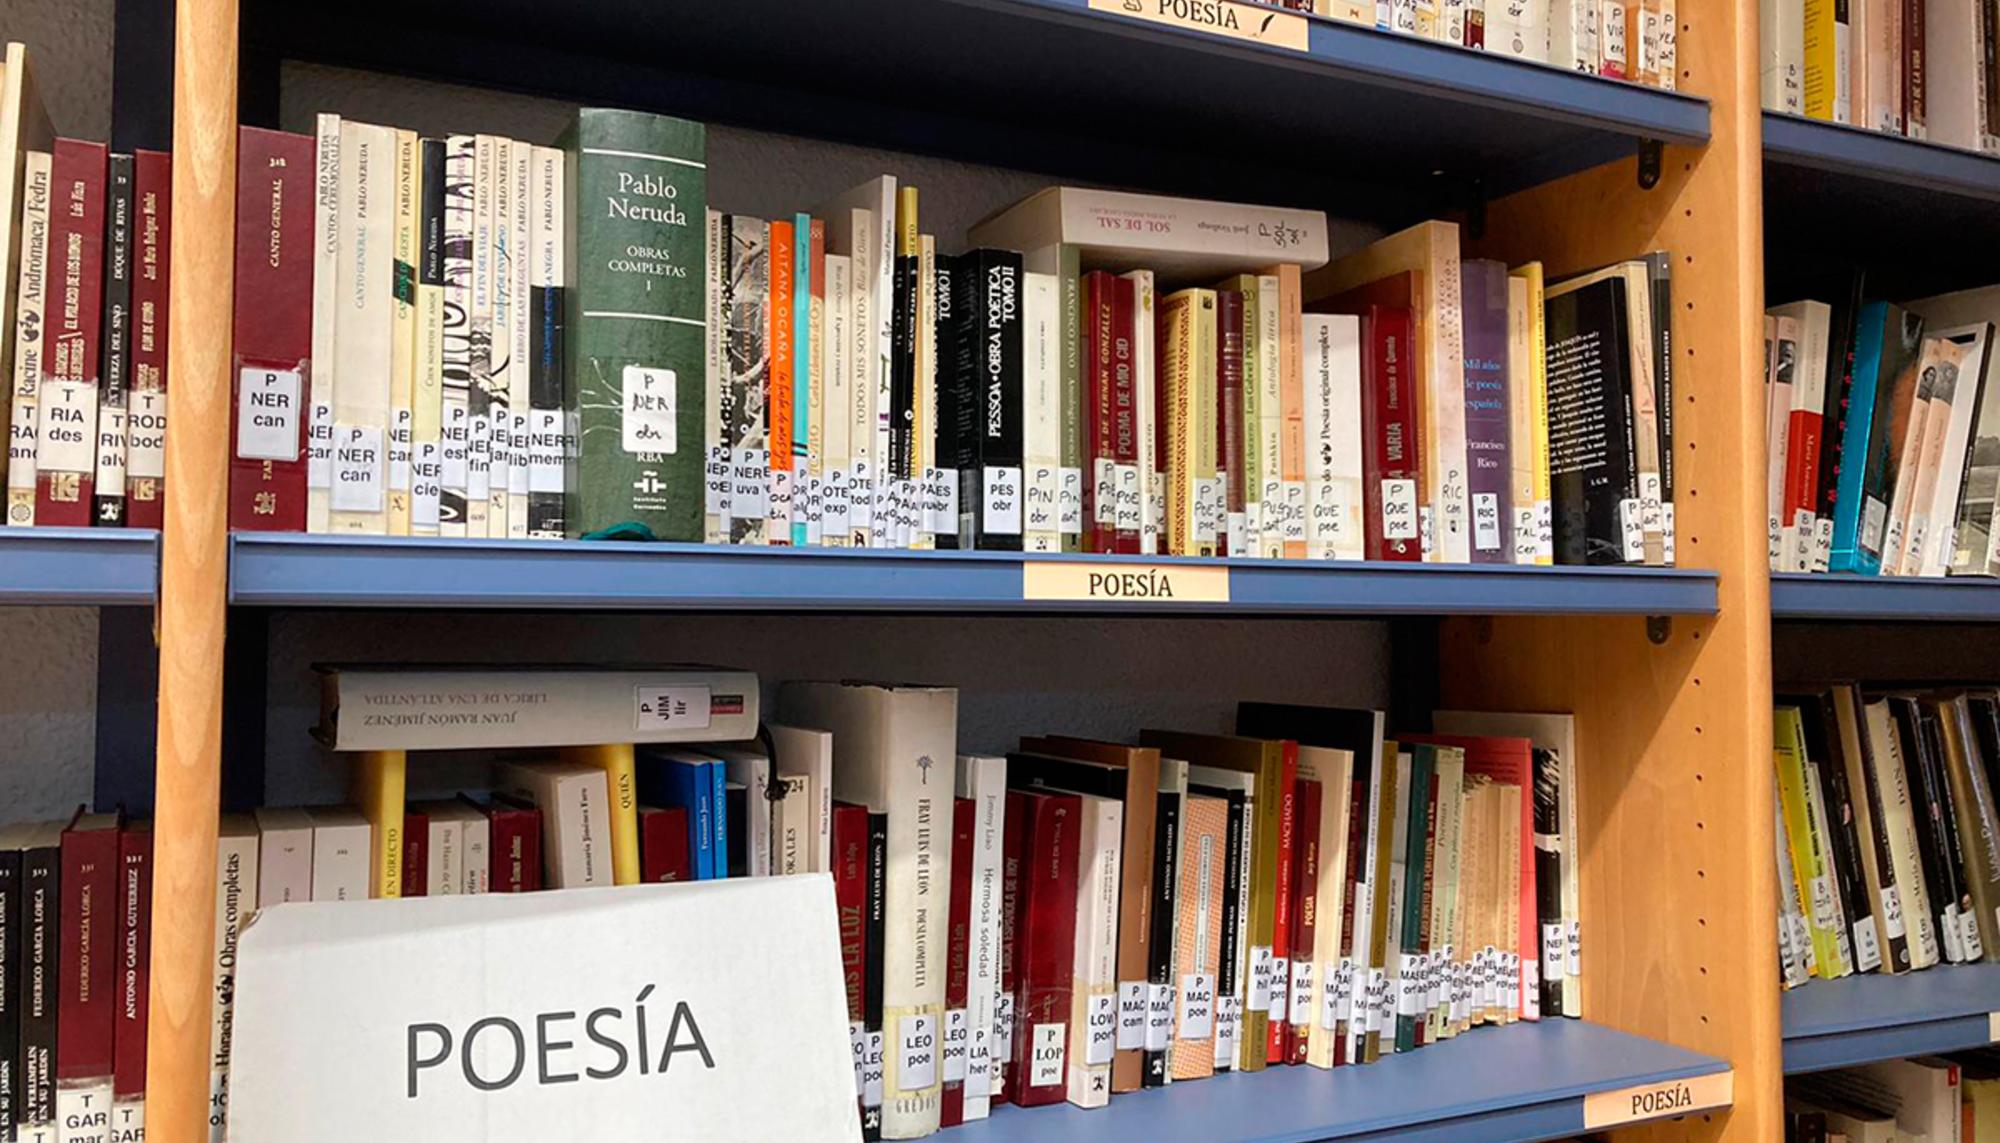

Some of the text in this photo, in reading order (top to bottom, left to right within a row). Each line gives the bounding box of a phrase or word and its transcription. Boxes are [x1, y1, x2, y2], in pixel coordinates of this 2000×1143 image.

[1159, 0, 1239, 30] POESÍA
[480, 142, 489, 218] PABLO NERUDA
[617, 172, 677, 199] Pablo
[518, 159, 528, 233] PABLO NERUDA
[545, 159, 555, 232] PABLO NERUDA
[607, 197, 687, 226] Neruda
[270, 179, 283, 267] CANTO GENERAL
[1096, 217, 1171, 233] SOL DE SAL
[115, 229, 124, 242] DE
[627, 246, 669, 261] OBRAS
[608, 260, 686, 279] COMPLETAS
[778, 242, 789, 302] AITANA
[18, 171, 48, 398] Racine Andrómaca/Fedra
[938, 276, 951, 322] TOMO
[1002, 276, 1015, 323] TOMO
[777, 306, 791, 363] OCAÑA
[1244, 310, 1254, 359] PORTILLO
[988, 265, 1002, 438] PESSOA OBRA POETICA
[855, 295, 866, 426] TODOS MIS SONETOS
[1101, 302, 1111, 435] DE FERNAN GONZALEZ
[265, 374, 277, 386] P
[1320, 325, 1331, 439] Poesía original completa
[62, 389, 75, 402] T
[143, 396, 155, 409] T
[251, 394, 290, 408] NER
[1115, 338, 1131, 455] POEMA DE MIO CID
[23, 406, 34, 420] T
[51, 408, 84, 424] RIA
[316, 405, 328, 419] P
[399, 411, 410, 425] P
[453, 409, 465, 423] P
[113, 415, 124, 428] T
[128, 415, 166, 431] ROD
[253, 416, 286, 428] can
[475, 421, 486, 434] P
[543, 416, 555, 430] P
[49, 427, 83, 443] des
[352, 430, 363, 442] P
[1387, 422, 1403, 460] VARIA
[337, 448, 375, 463] NER
[422, 444, 434, 457] P
[745, 451, 754, 463] P
[857, 463, 866, 474] P
[1477, 457, 1498, 469] Rico
[340, 470, 372, 483] can
[833, 471, 841, 483] P
[997, 469, 1006, 480] P
[414, 484, 439, 498] cie
[737, 484, 760, 496] uva
[823, 487, 849, 499] OTE
[990, 485, 1014, 497] PES
[1028, 487, 1054, 503] PIN
[1116, 490, 1140, 505] POE
[1391, 483, 1403, 497] P
[1442, 484, 1462, 500] RIC
[851, 494, 871, 505] tod
[992, 499, 1011, 511] obr
[824, 502, 848, 516] exp
[1313, 504, 1340, 518] QUE
[1385, 501, 1409, 516] QUE
[1478, 508, 1495, 518] RIC
[1318, 522, 1340, 538] poe
[1389, 521, 1409, 537] poe
[1089, 568, 1173, 598] POESÍA
[363, 692, 547, 706] LÍRICA DE UNA ATLÁNTIDA
[657, 695, 670, 722] JIM
[362, 711, 517, 729] JUAN RAMÓN JIMÉNEZ
[618, 773, 631, 809] QUIÉN
[1282, 794, 1293, 848] MACHADO
[917, 798, 931, 867] FRAY LUIS DE
[386, 828, 397, 895] EN DIRECTO
[978, 795, 996, 978] Jimmy Liao Hermosa soledad
[842, 905, 860, 965] LA LUZ
[80, 885, 91, 1003] FEDERICO LORCA
[126, 868, 138, 1020] ANTONIO GARCIA GUTIERREZ
[34, 889, 44, 1017] FEDERICO GARCIA LORCA
[215, 853, 241, 1068] Horacio Obras completas
[1195, 978, 1204, 988] P
[1132, 985, 1140, 997] P
[1186, 991, 1210, 1003] MAC
[1100, 998, 1109, 1011] P
[1122, 1000, 1146, 1012] MAC
[952, 1012, 961, 1025] P
[1187, 1007, 1207, 1019] poe
[915, 1020, 925, 1032] P
[407, 983, 716, 1099] POESÍA
[906, 1035, 933, 1050] LEO
[943, 1028, 968, 1042] LEO
[976, 1029, 985, 1042] P
[1047, 1029, 1055, 1042] P
[943, 1044, 965, 1060] poe
[970, 1047, 989, 1059] LIA
[1036, 1046, 1063, 1061] LOP
[907, 1052, 931, 1068] poe
[969, 1062, 988, 1076] her
[1040, 1065, 1058, 1078] poe
[39, 1049, 49, 1120] EN SU JARDIN
[81, 1095, 94, 1108] T
[896, 1098, 935, 1114] GREDOS
[1632, 1082, 1693, 1116] POESÍA
[66, 1112, 107, 1129] GAR
[121, 1109, 134, 1122] T
